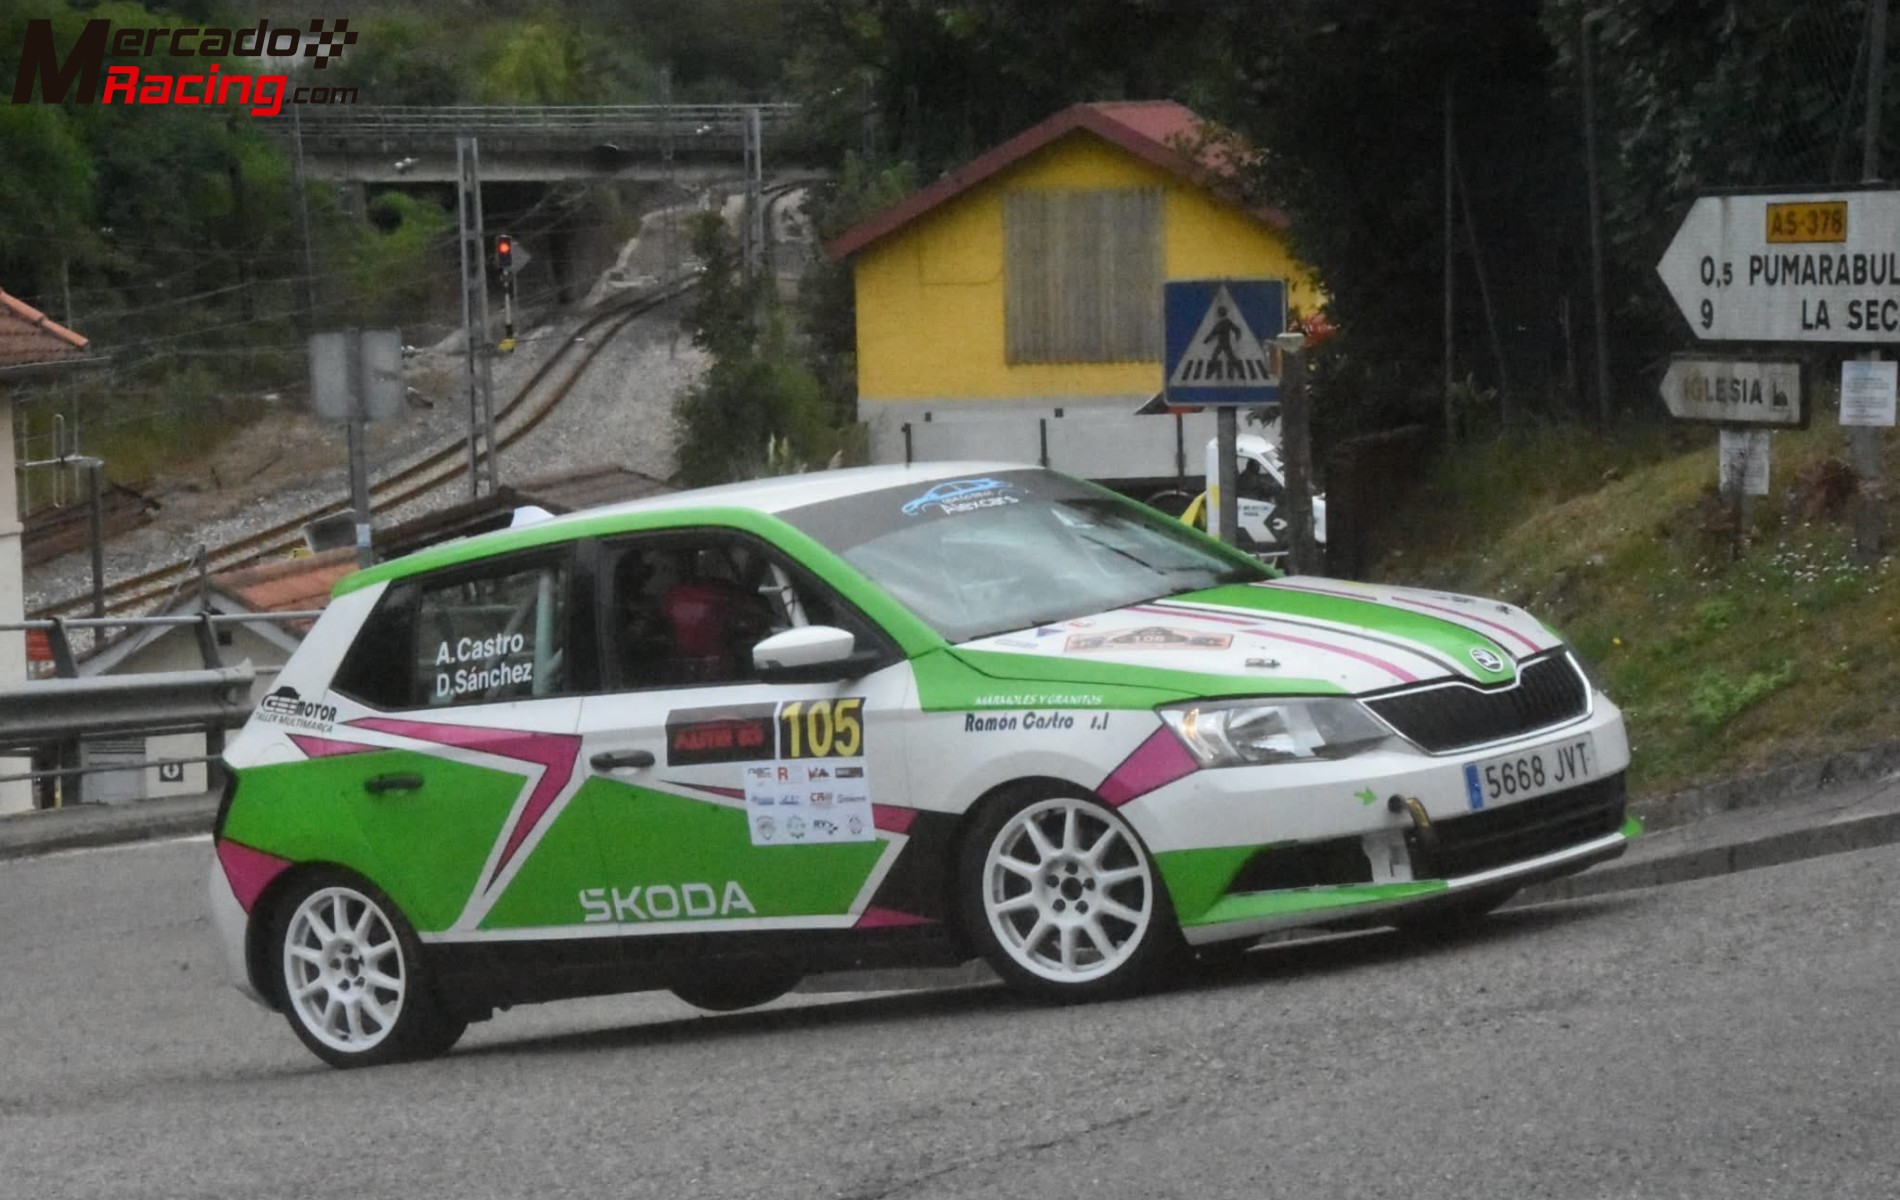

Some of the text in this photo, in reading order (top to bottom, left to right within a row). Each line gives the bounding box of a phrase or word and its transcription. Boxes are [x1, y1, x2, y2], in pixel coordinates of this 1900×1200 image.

[1771, 207, 1843, 236] AS-378
[1700, 253, 1900, 288] 0,5 PUMARABUL
[1701, 299, 1900, 331] 9 LA SEC
[436, 634, 524, 666] A.Castro
[436, 662, 533, 697] D.Sánchez
[782, 698, 861, 757] 105
[965, 712, 1017, 732] Ramón
[1023, 711, 1074, 731] Castro
[1485, 742, 1588, 798] 5668 JVT
